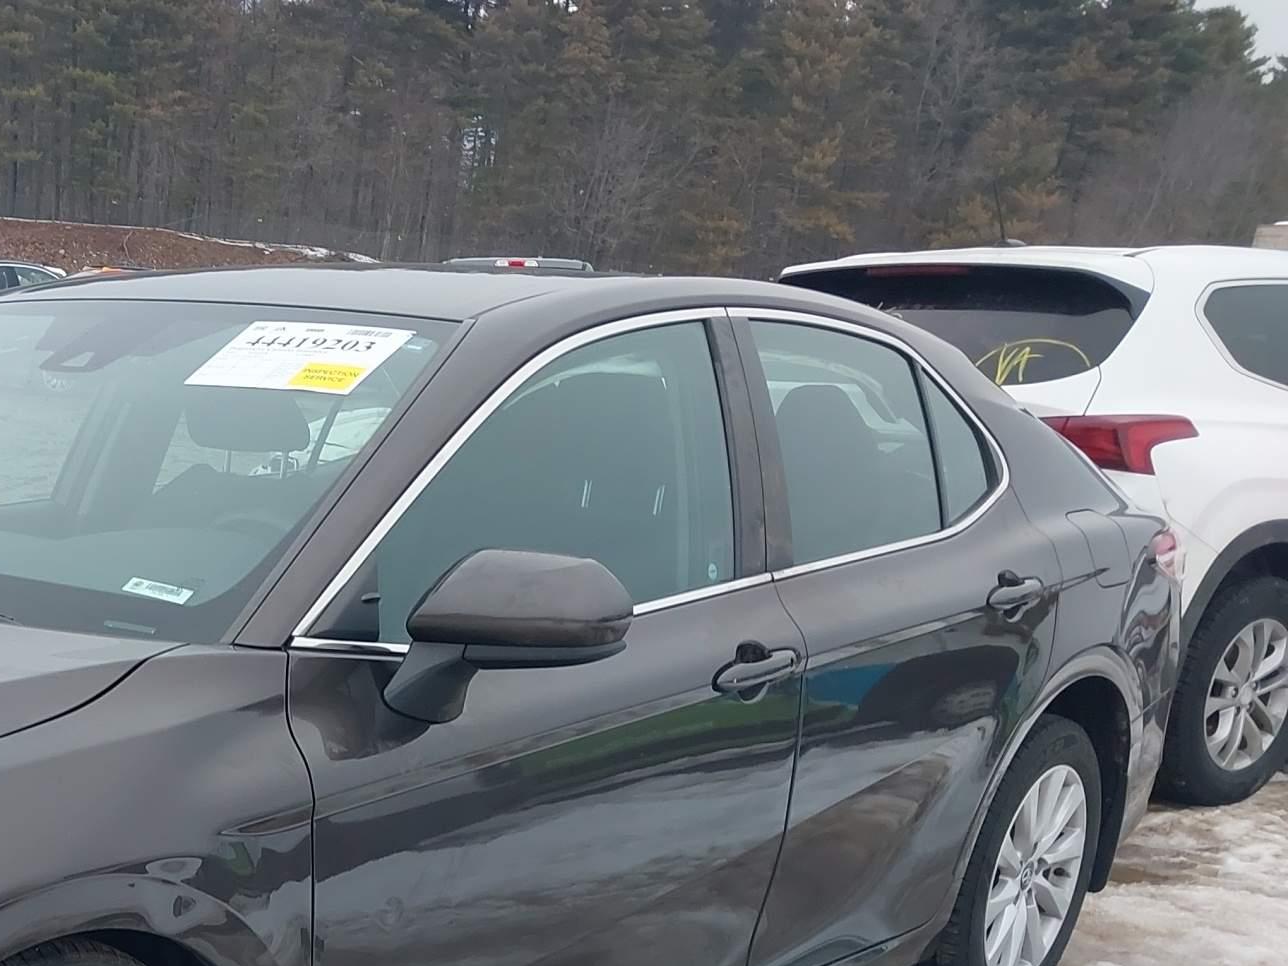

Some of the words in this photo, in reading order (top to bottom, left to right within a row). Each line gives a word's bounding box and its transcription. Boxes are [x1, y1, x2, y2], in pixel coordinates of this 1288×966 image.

[245, 335, 376, 353] 44419203
[302, 367, 360, 378] INSPECTION
[302, 374, 346, 383] SERVICE
